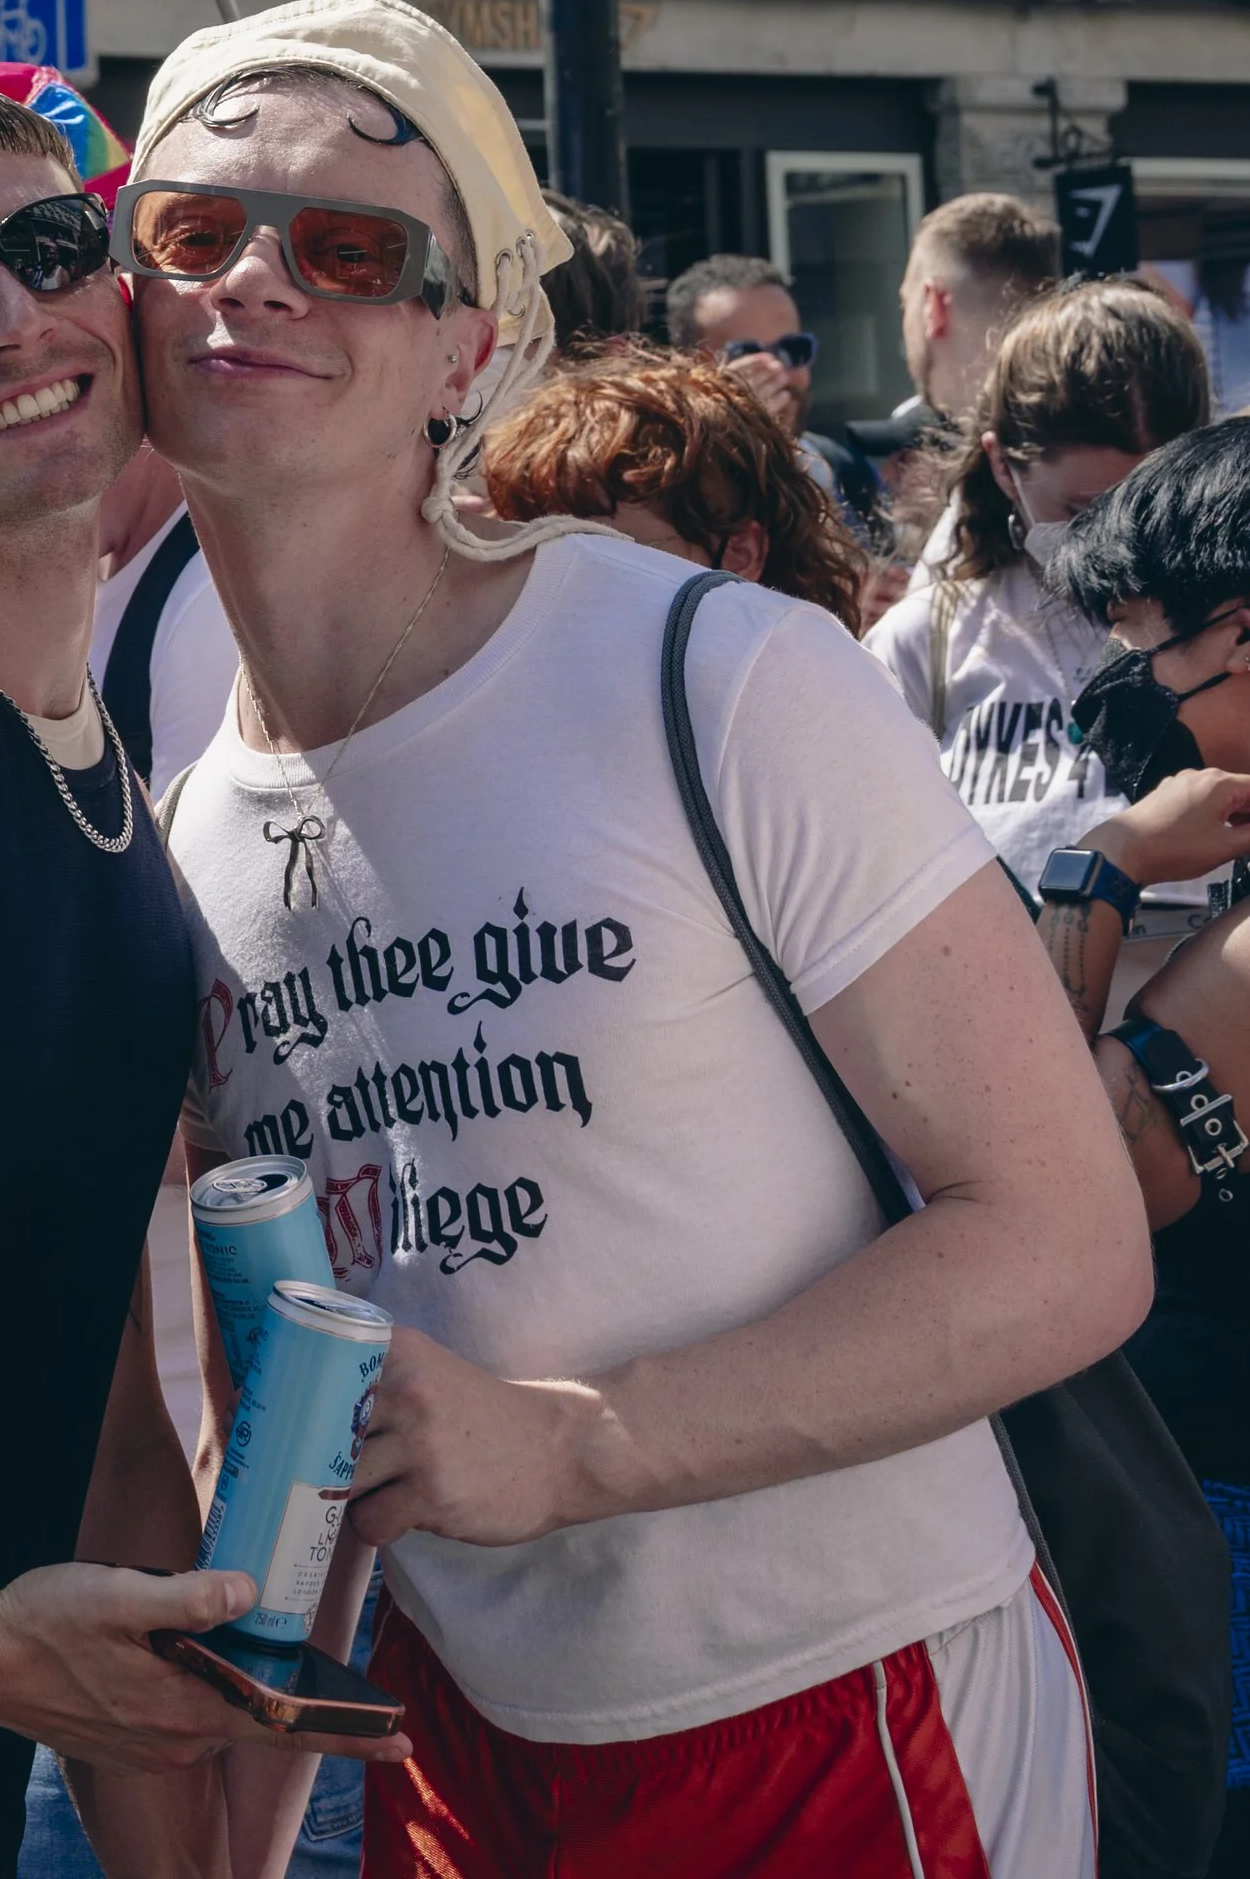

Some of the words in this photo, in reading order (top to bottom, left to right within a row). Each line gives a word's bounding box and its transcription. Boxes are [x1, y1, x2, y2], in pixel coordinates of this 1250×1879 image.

[325, 916, 455, 1013] thee
[446, 885, 637, 1016] give
[244, 1098, 315, 1160] me
[325, 1019, 593, 1143] attention
